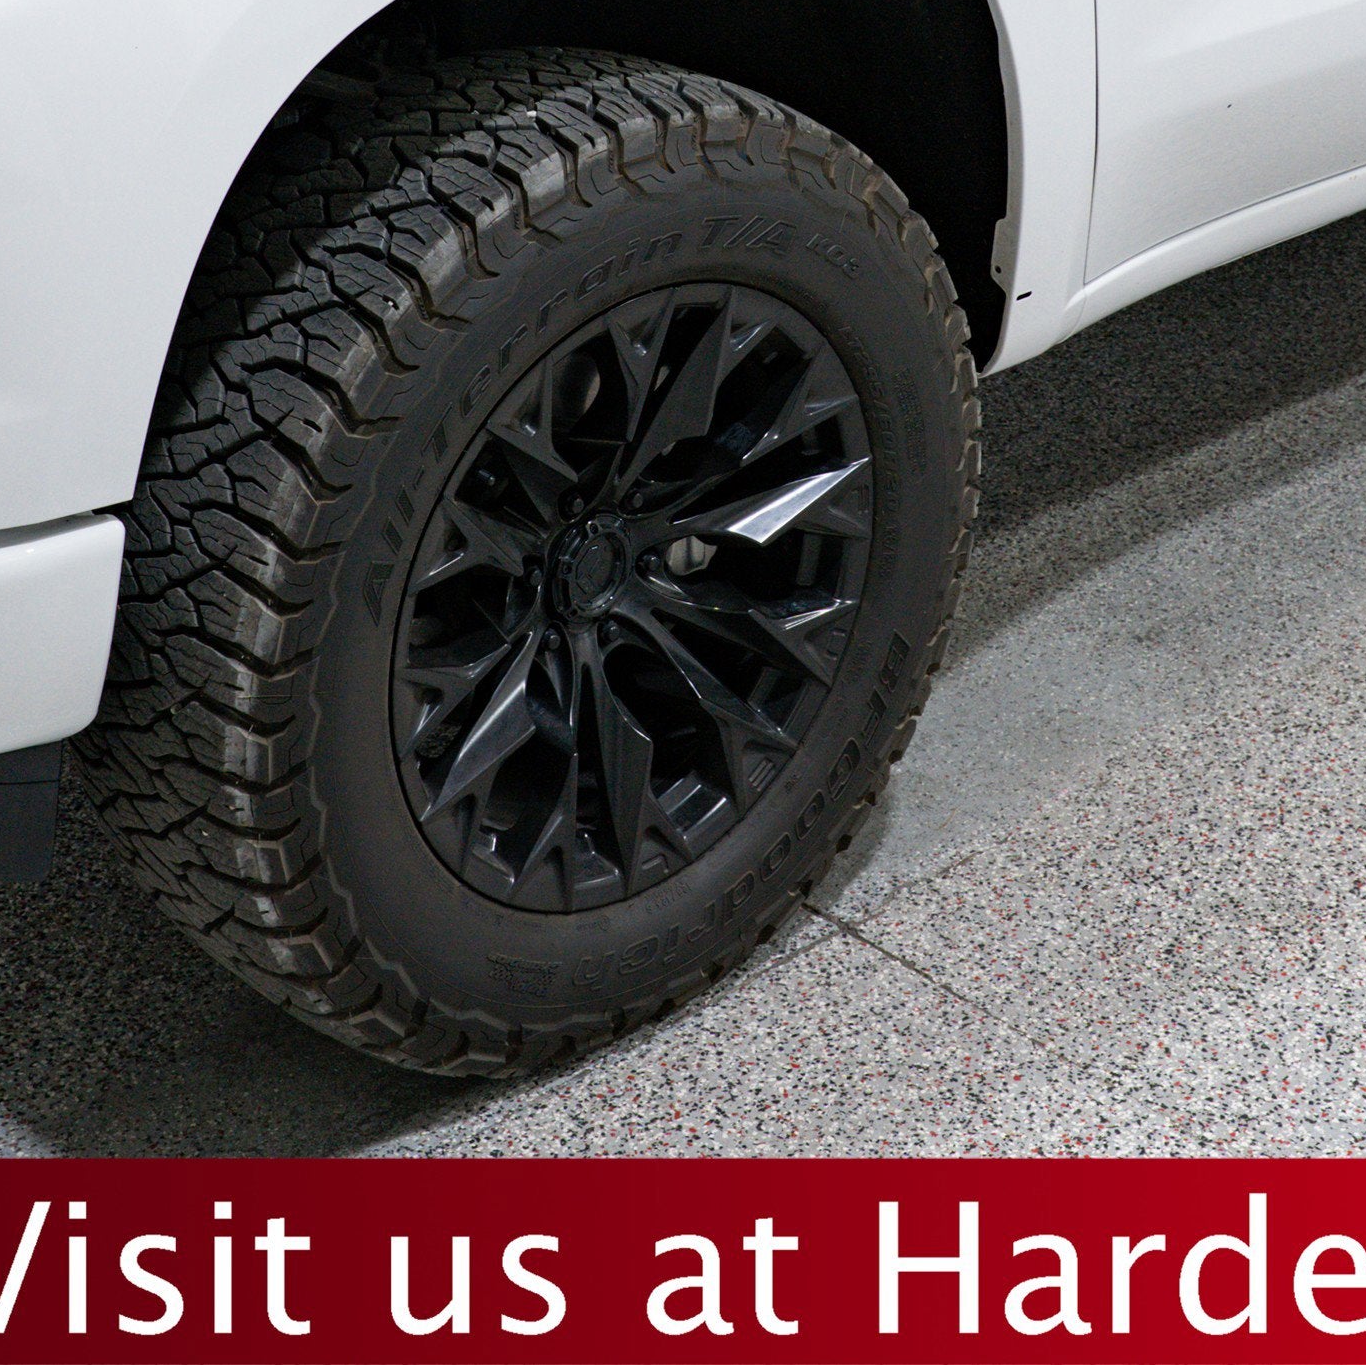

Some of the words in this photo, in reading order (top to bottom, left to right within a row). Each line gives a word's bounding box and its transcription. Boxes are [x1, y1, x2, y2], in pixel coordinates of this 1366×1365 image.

[363, 230, 683, 626] All-Terrain
[700, 214, 797, 256] T/A
[572, 631, 910, 991] BFGoodrich
